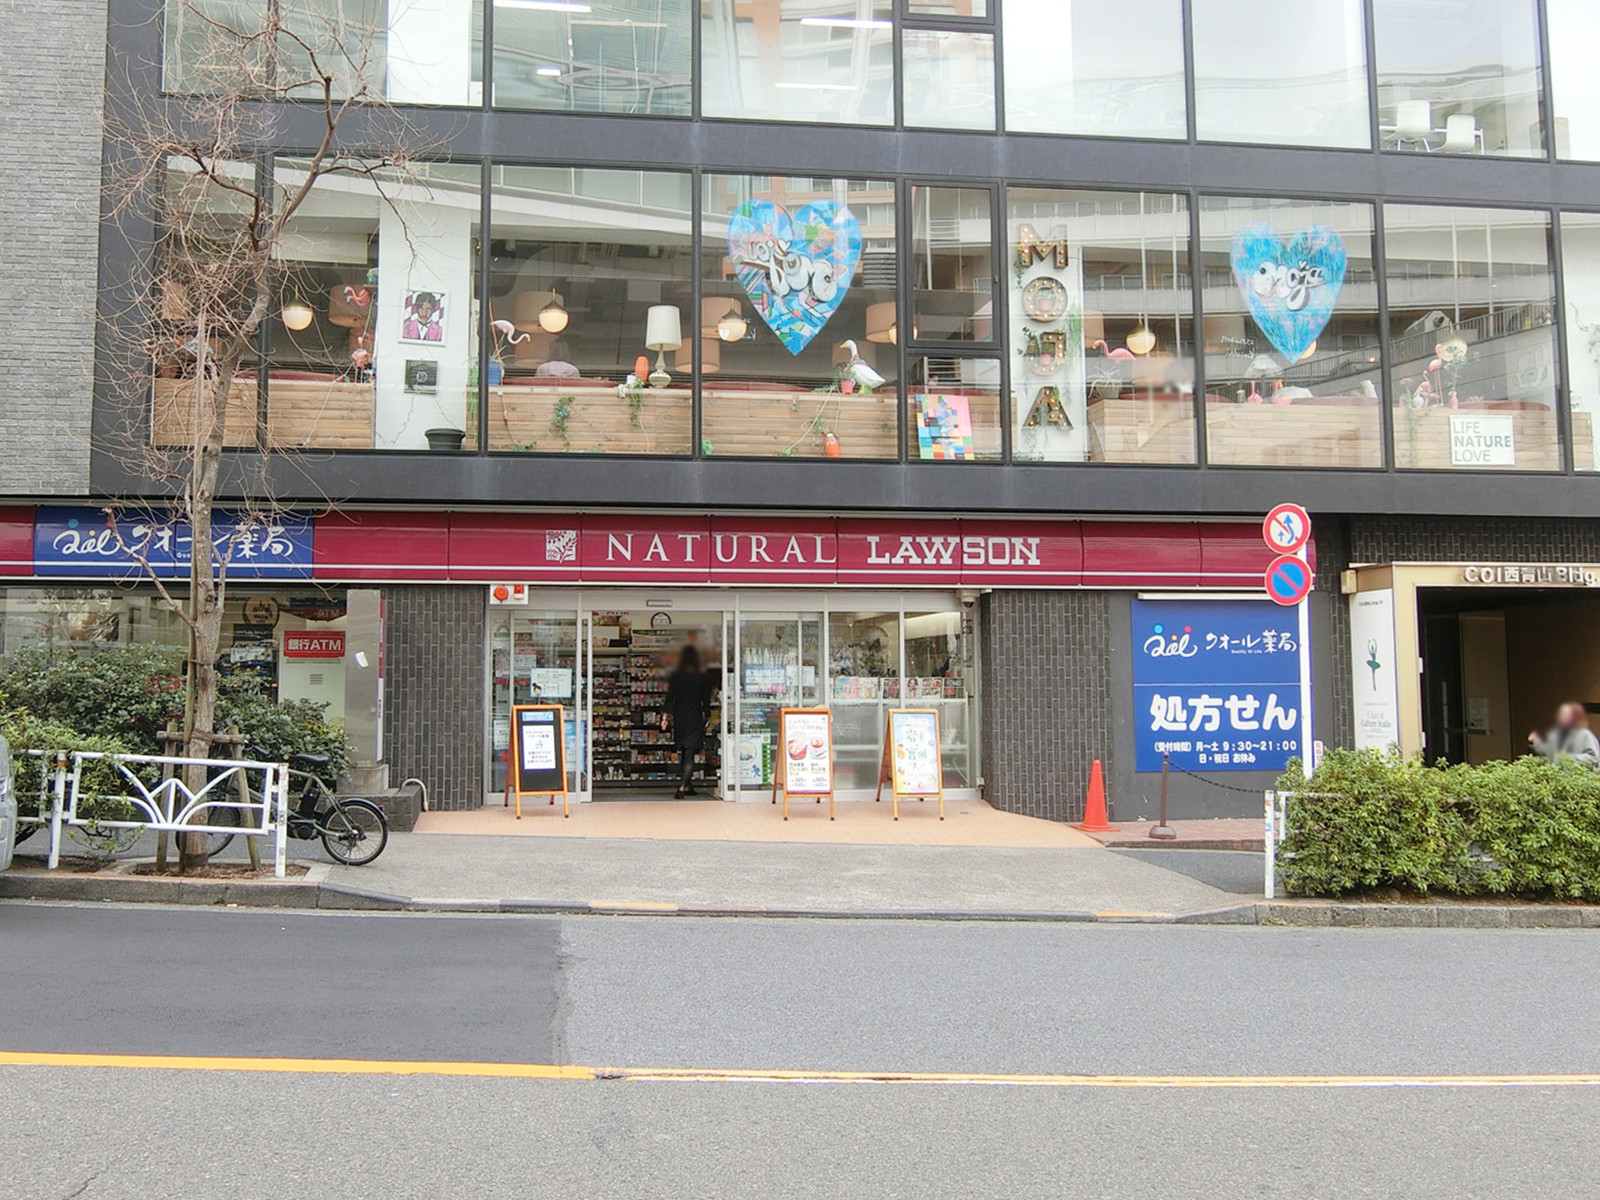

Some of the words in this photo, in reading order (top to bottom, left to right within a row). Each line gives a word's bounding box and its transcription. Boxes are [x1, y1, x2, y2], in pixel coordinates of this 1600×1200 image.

[1453, 421, 1480, 433] LIFE
[1454, 435, 1511, 448] NATURE
[1454, 449, 1491, 462] LOVE
[132, 522, 294, 559] クオー薬局
[606, 532, 836, 564] NATURAL
[867, 535, 1041, 566] LAWSON
[287, 638, 341, 651] 銀行ATM
[1205, 629, 1297, 653] クオール薬局
[1150, 693, 1297, 732] 処方せん
